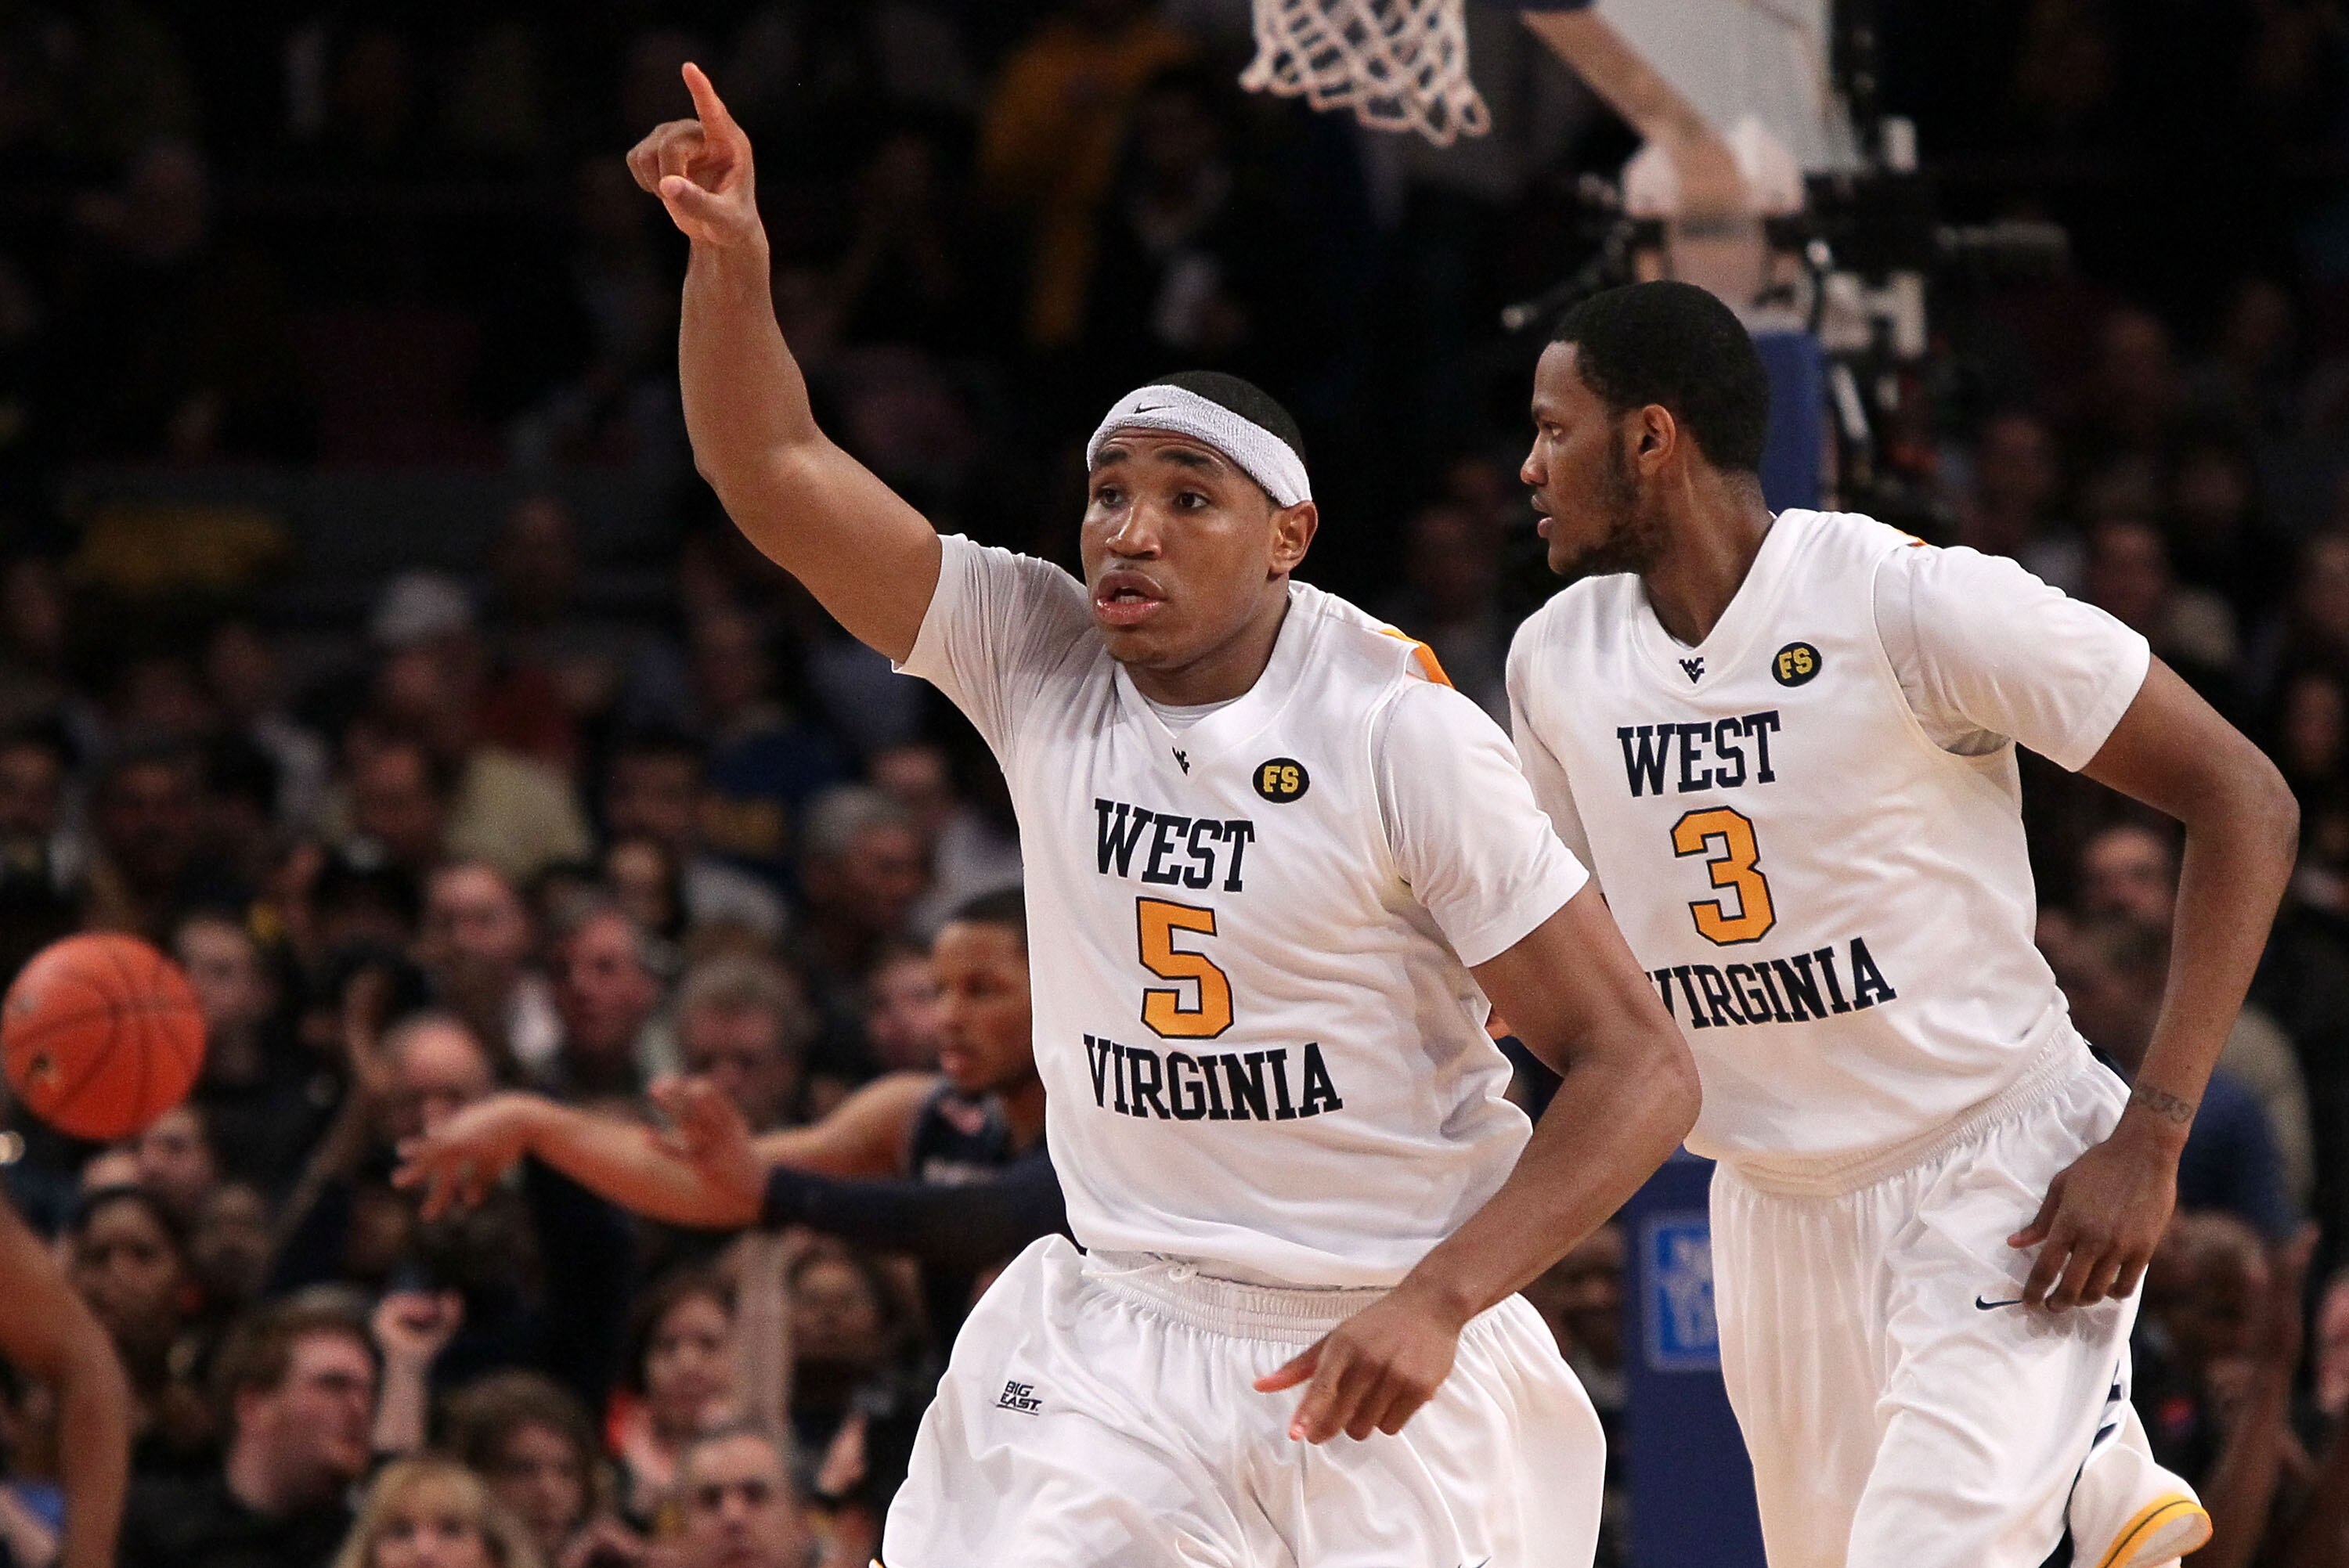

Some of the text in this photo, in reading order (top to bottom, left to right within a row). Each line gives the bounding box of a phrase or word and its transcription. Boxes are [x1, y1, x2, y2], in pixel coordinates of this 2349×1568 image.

[1777, 647, 1814, 680] FS
[1262, 764, 1300, 794] FS
[1617, 710, 1781, 797] WEST
[1095, 798, 1255, 892] WEST
[1670, 805, 1777, 946] 3
[1135, 896, 1234, 1039] 5
[1083, 1033, 1344, 1121] VIRGINIA
[1001, 1393, 1042, 1411] EAST
[1005, 1381, 1034, 1397] BIG
